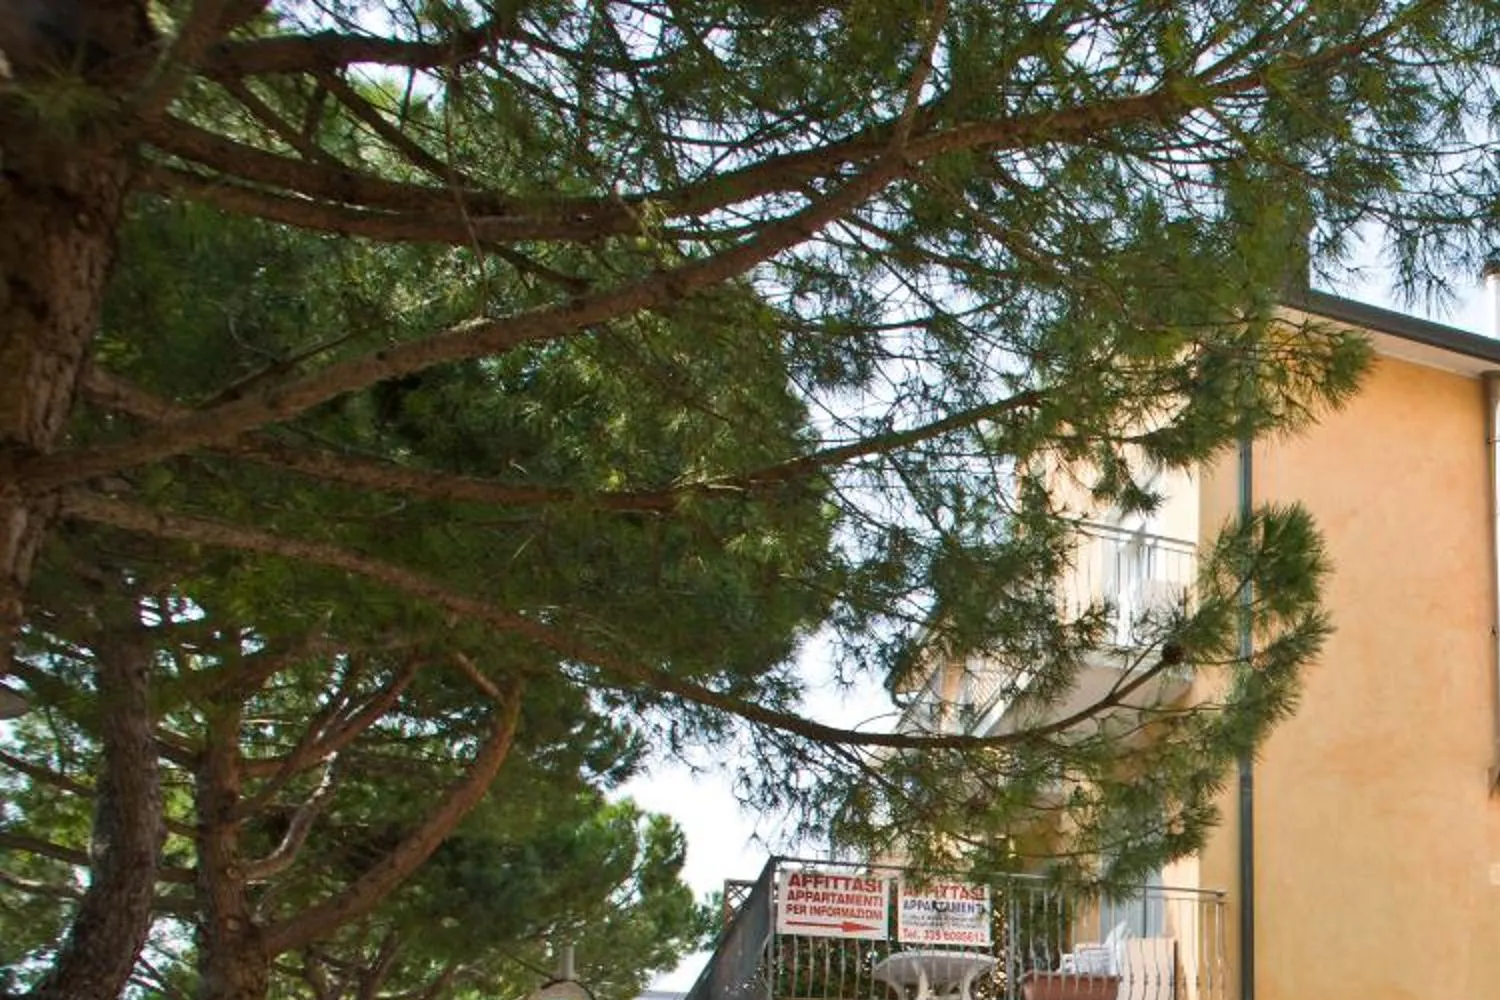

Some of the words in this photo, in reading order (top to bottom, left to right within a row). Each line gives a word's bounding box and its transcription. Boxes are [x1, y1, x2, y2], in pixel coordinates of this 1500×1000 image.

[788, 873, 883, 893] AFFITTASI
[787, 889, 884, 908] APPARTAMENTI
[785, 903, 807, 916] PER
